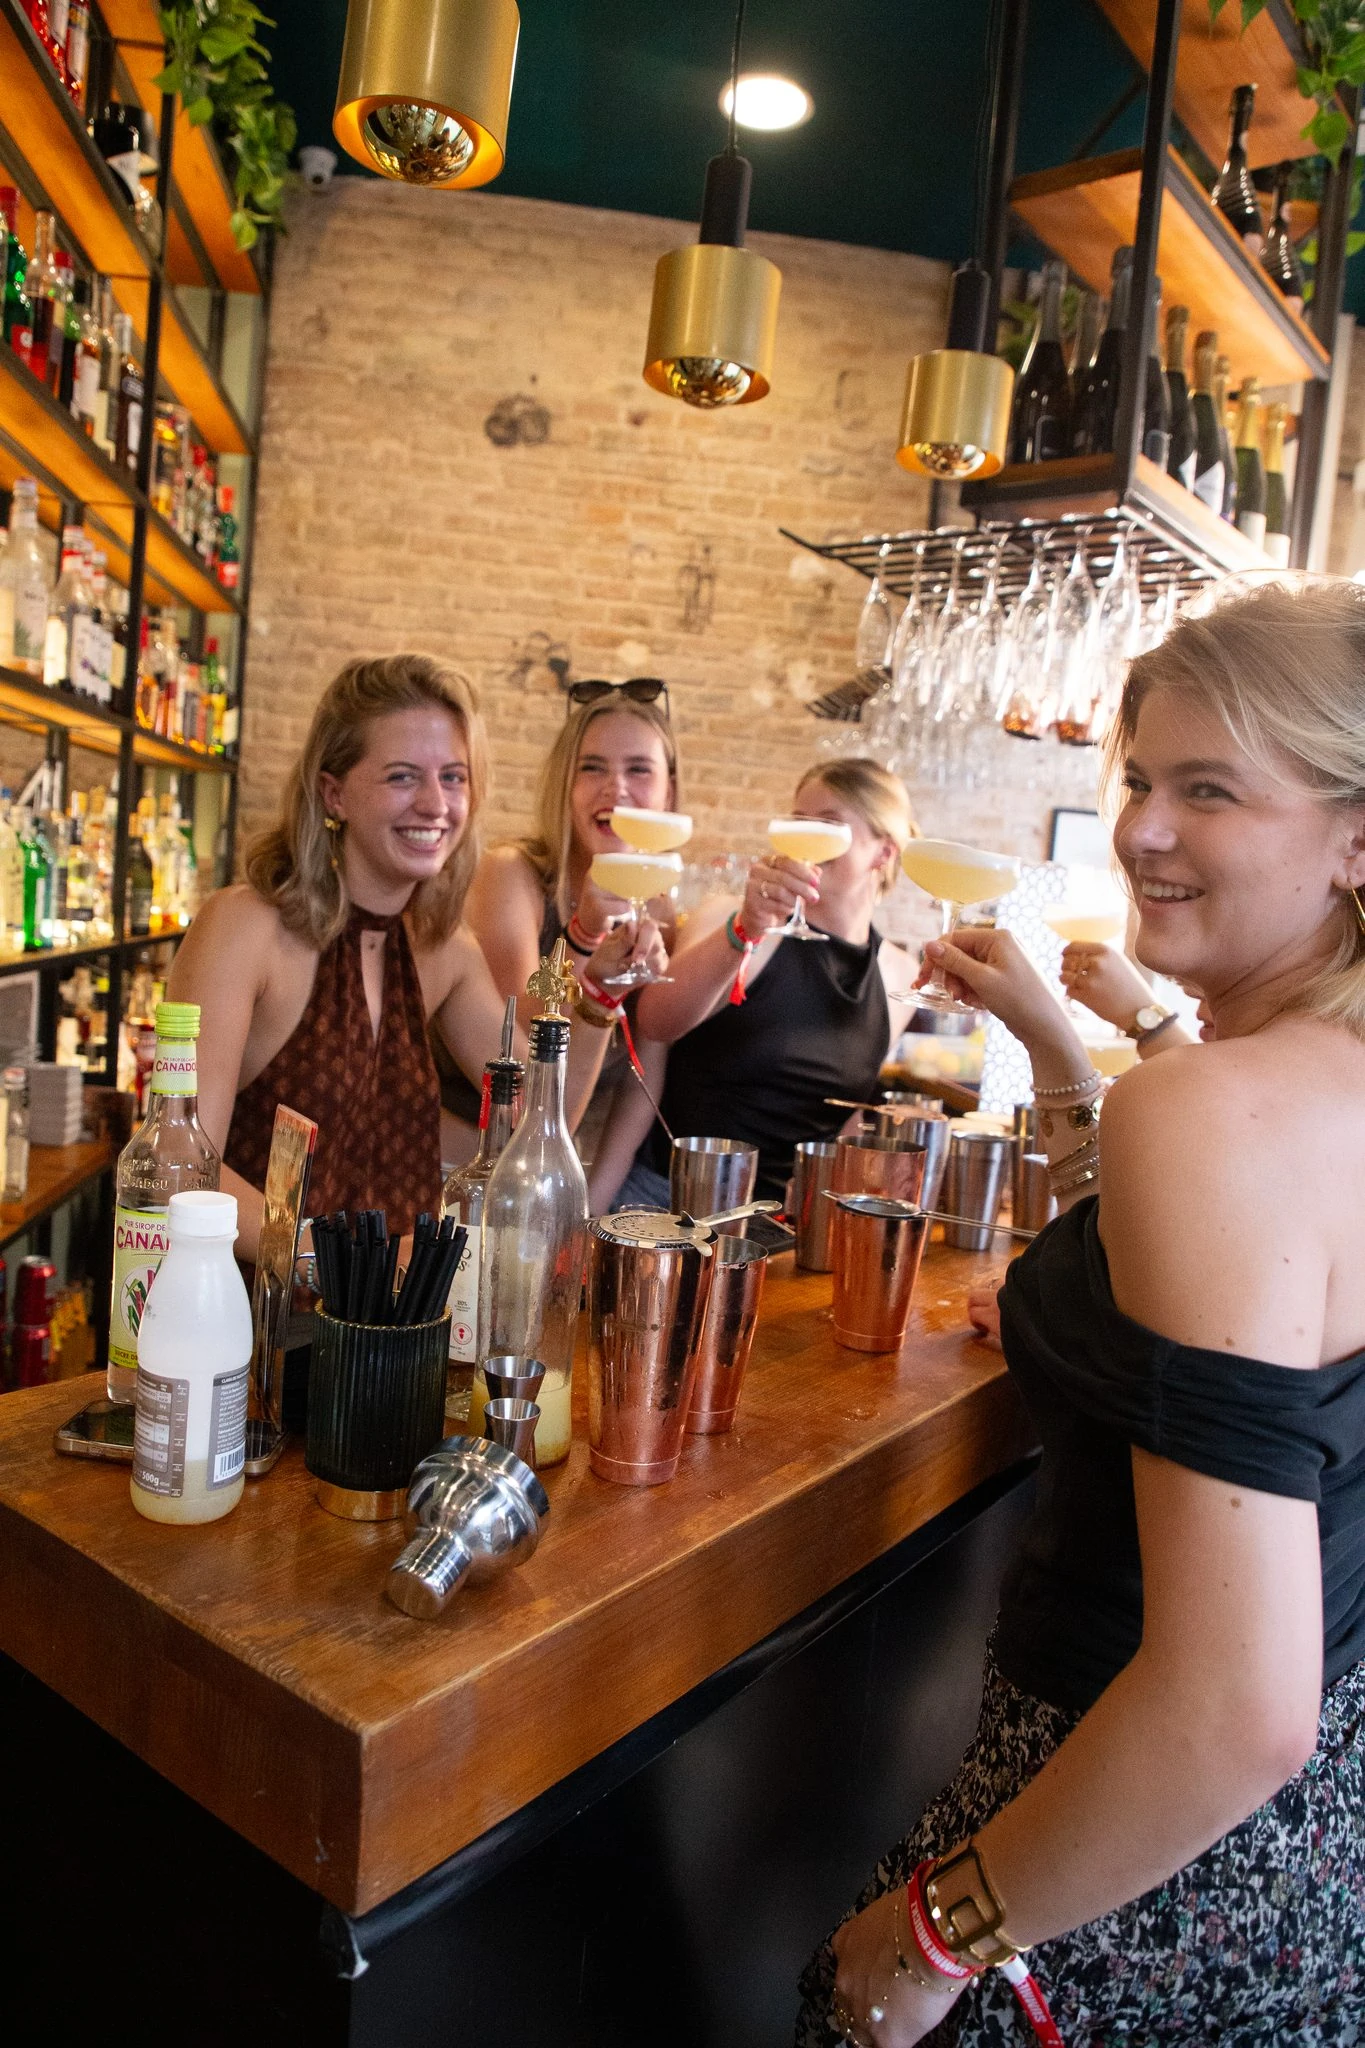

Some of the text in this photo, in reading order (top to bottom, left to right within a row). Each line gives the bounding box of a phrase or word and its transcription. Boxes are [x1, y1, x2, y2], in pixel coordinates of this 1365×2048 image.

[124, 1219, 134, 1228] PUR
[134, 1222, 155, 1231] SIROP
[142, 1471, 160, 1487] 500g
